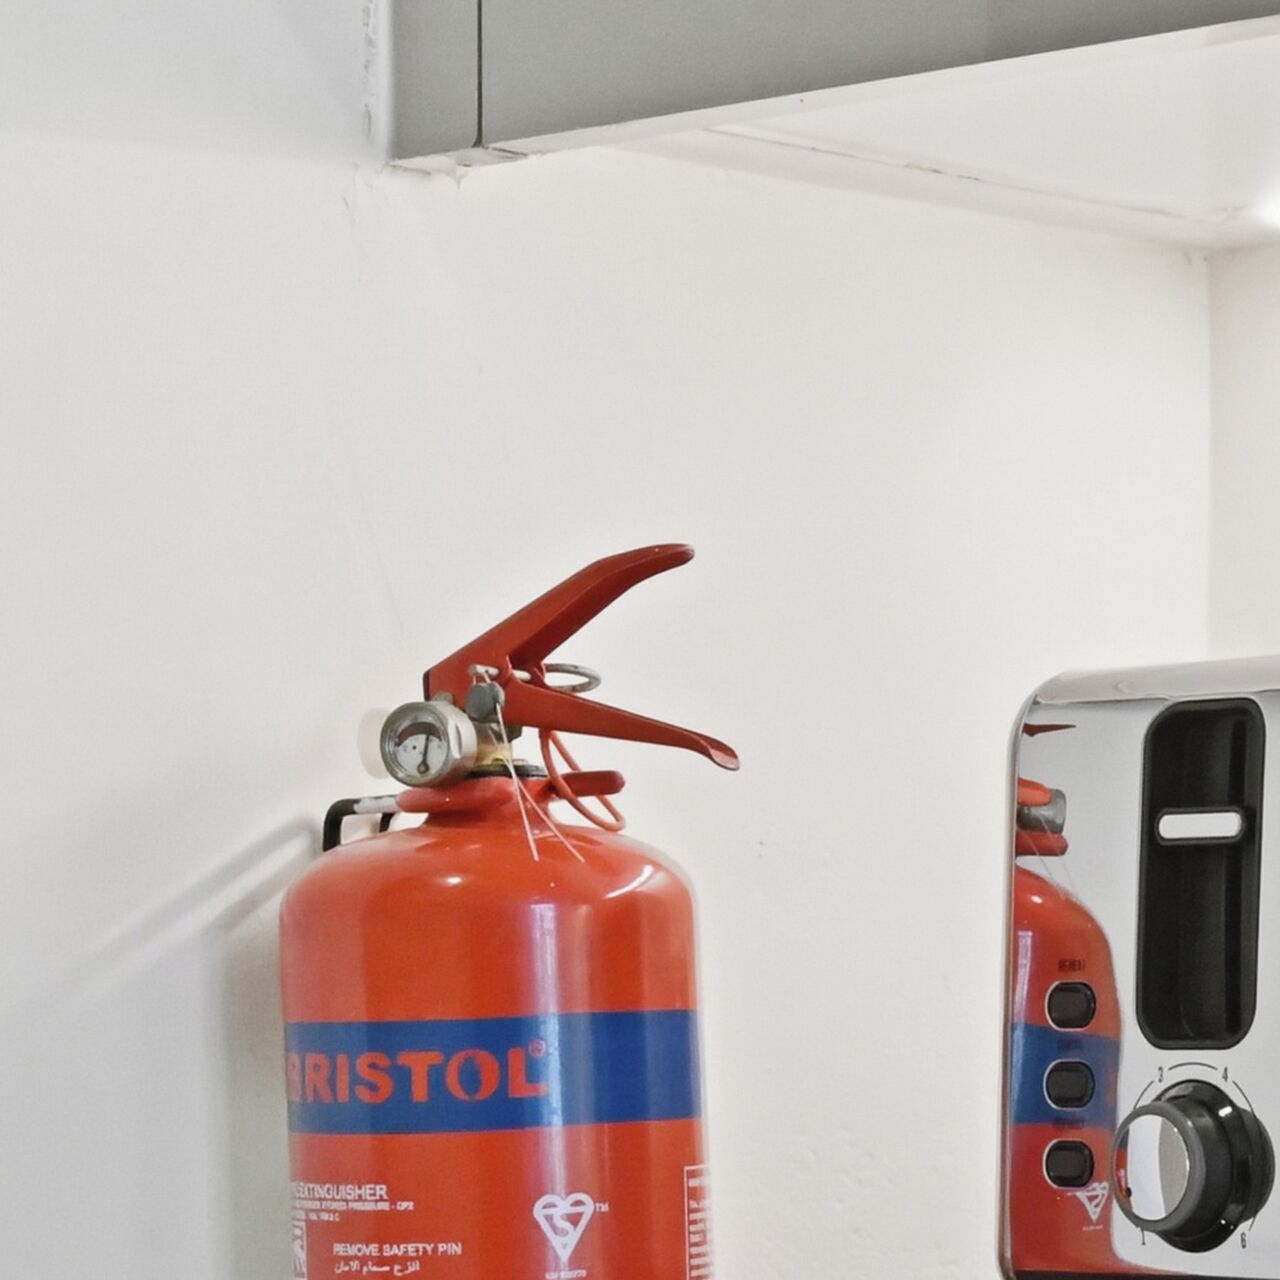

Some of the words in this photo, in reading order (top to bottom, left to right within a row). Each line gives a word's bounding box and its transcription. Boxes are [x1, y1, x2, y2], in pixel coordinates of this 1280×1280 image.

[1158, 1066, 1164, 1083] 3
[1221, 1066, 1229, 1082] 4
[1240, 1233, 1247, 1249] 6
[333, 1243, 379, 1256] REMOVE
[383, 1243, 434, 1257] SAFETY
[438, 1242, 462, 1256] PIN
